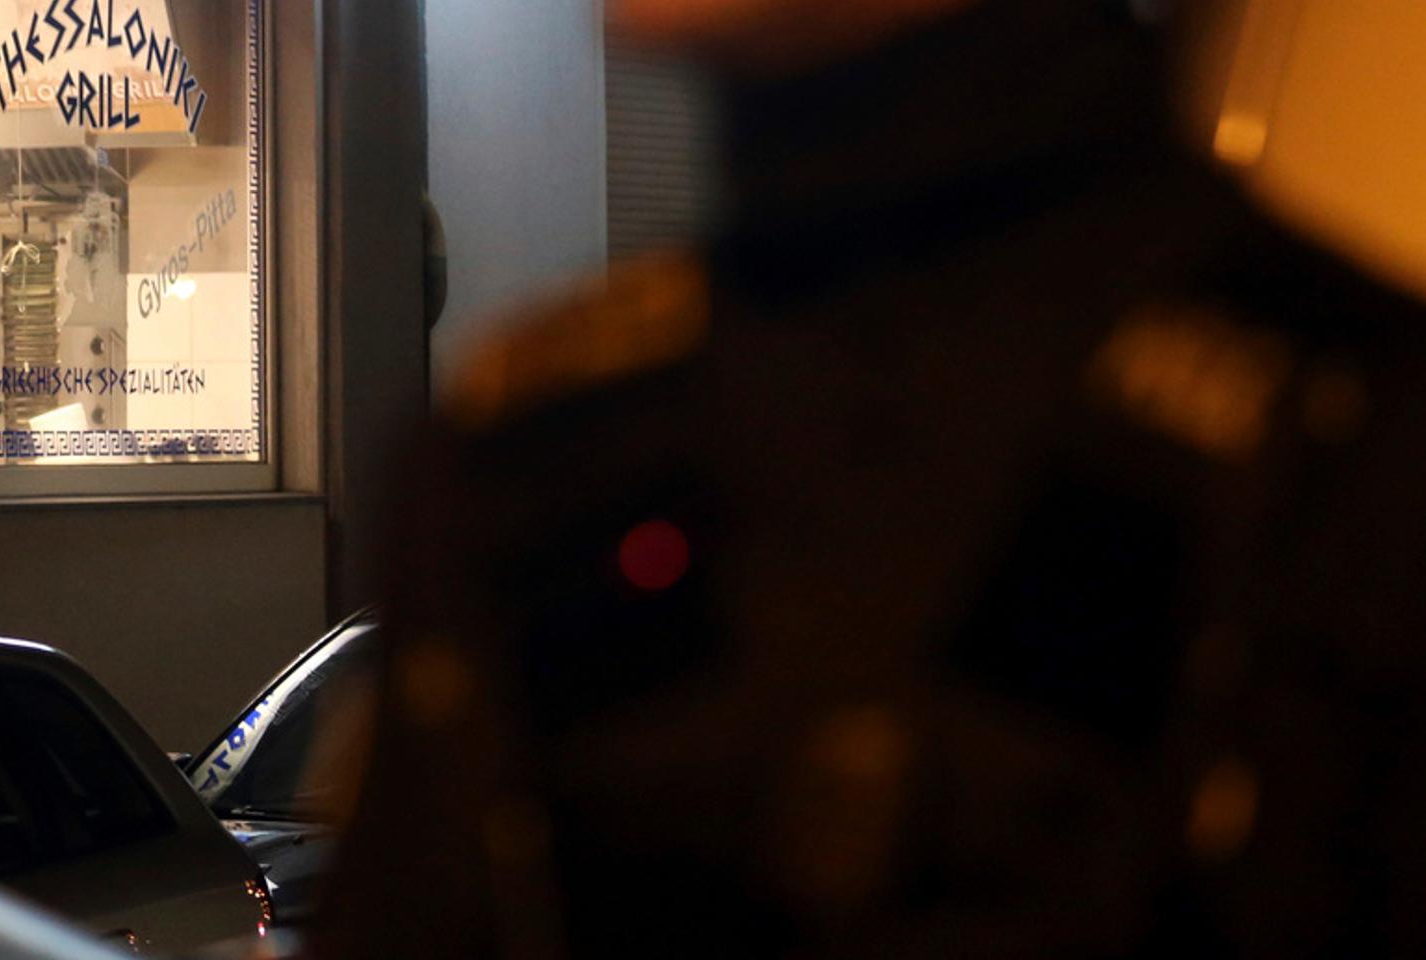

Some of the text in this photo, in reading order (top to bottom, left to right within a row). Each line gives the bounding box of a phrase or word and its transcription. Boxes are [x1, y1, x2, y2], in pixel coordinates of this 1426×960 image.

[56, 69, 141, 129] GRILL
[137, 188, 237, 319] Gyros-Pitta
[97, 363, 206, 395] SPEZIALITÄTEN
